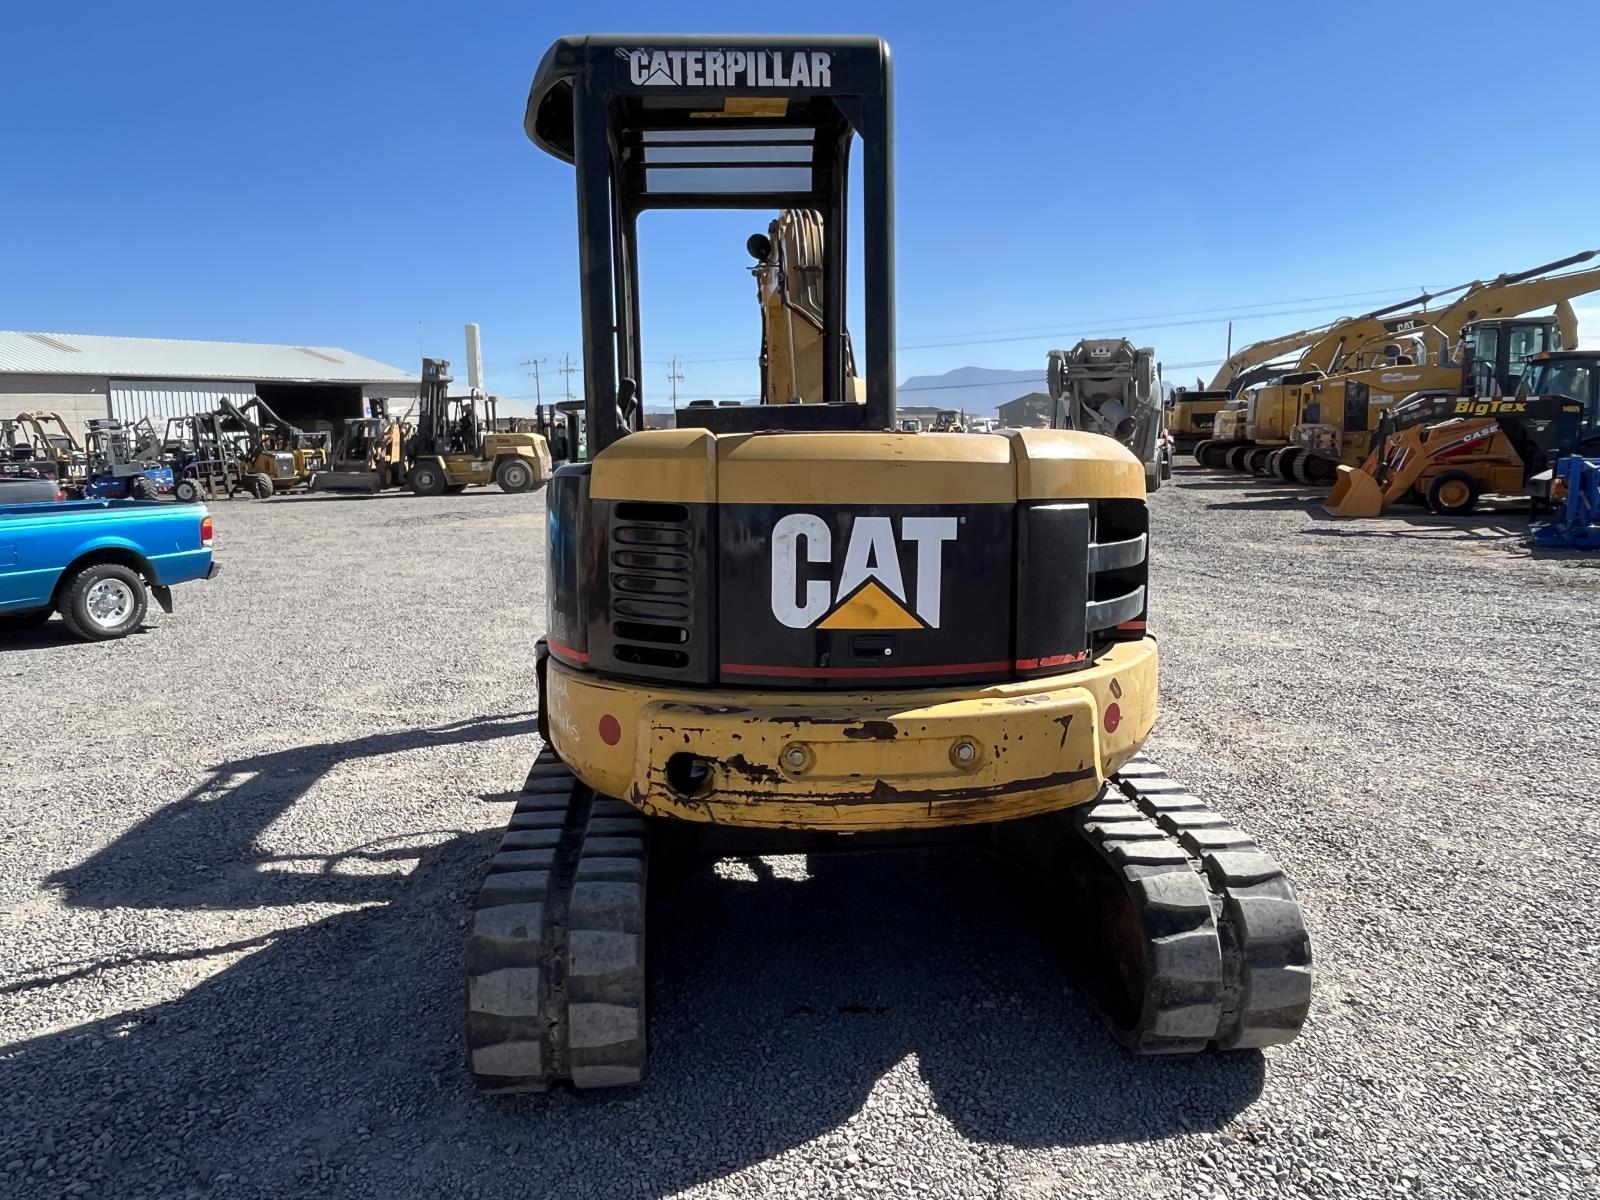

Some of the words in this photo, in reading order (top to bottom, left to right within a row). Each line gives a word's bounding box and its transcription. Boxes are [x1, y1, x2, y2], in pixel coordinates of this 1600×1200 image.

[629, 49, 832, 88] CATERPILLAR
[1397, 320, 1415, 332] CAT
[1463, 424, 1500, 443] CASE
[68, 465, 86, 476] CAT
[771, 513, 958, 629] CAT
